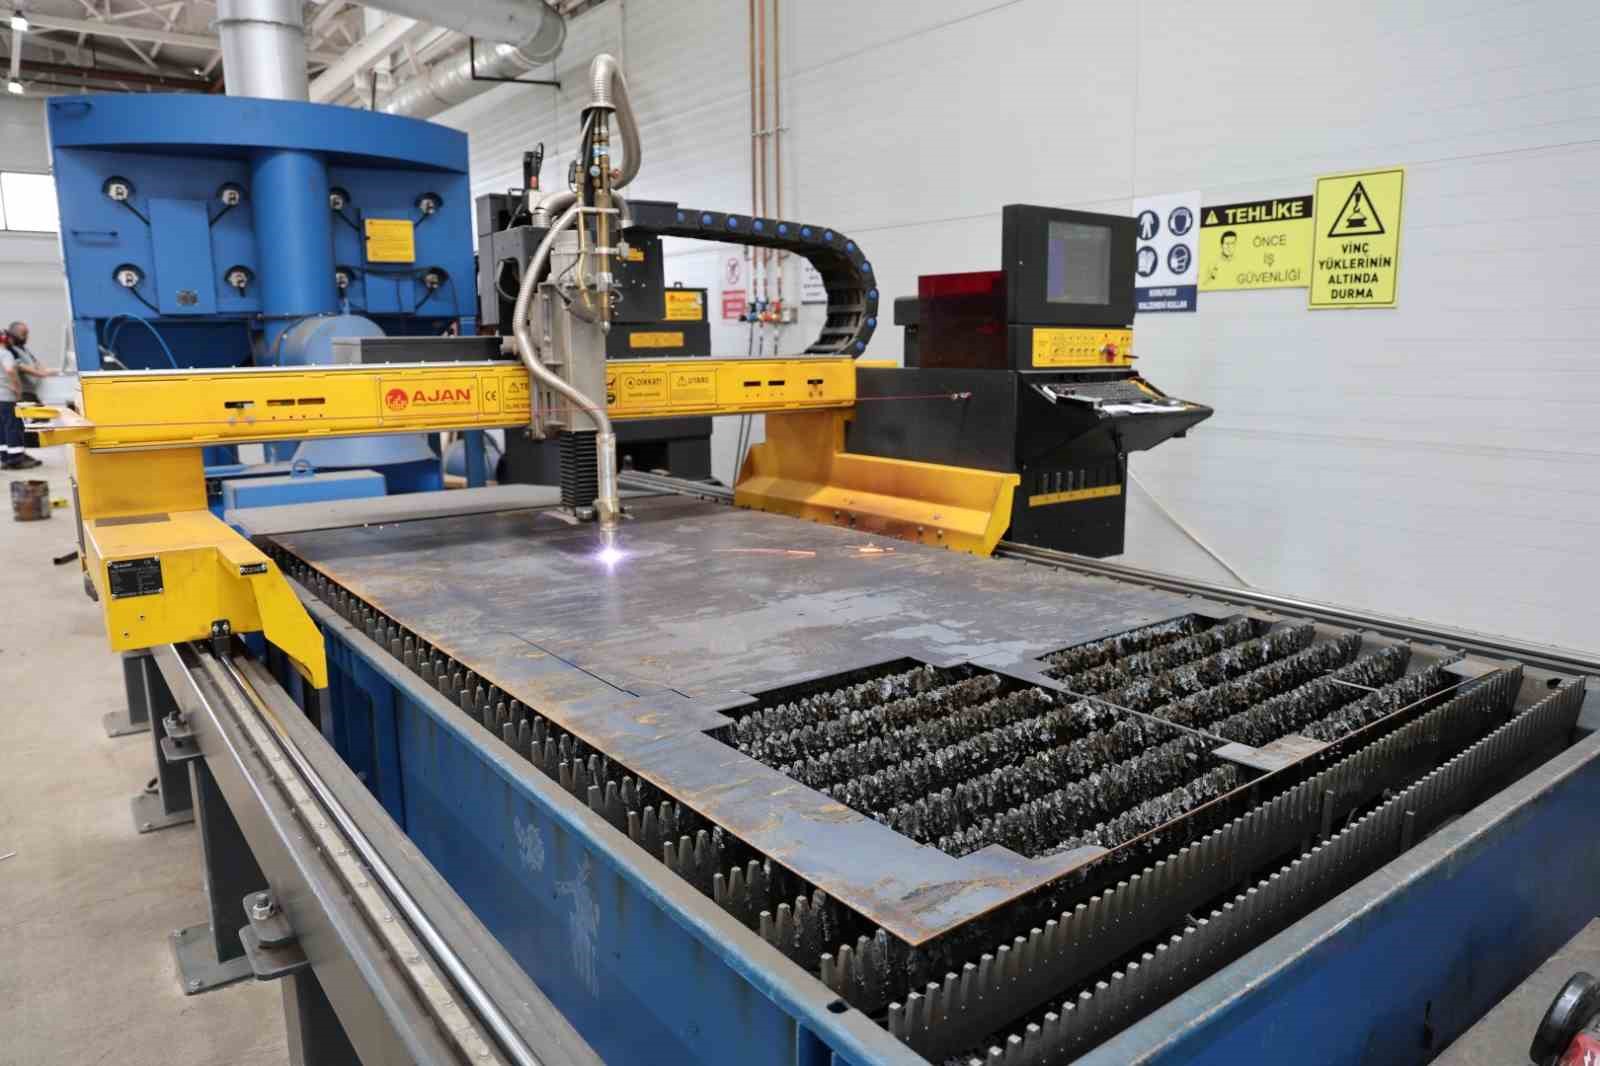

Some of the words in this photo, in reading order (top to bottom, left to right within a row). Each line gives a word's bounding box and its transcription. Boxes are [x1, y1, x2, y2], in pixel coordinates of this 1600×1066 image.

[1224, 200, 1304, 224] TEHLİKE
[1252, 234, 1287, 248] ÖNCE
[1341, 242, 1369, 256] VİNÇ
[1318, 254, 1392, 271] YÜKLERİNİN
[1328, 272, 1379, 285] ALTINDA
[1331, 288, 1374, 300] DURMA
[411, 387, 472, 403] AJAN
[484, 390, 498, 402] CE
